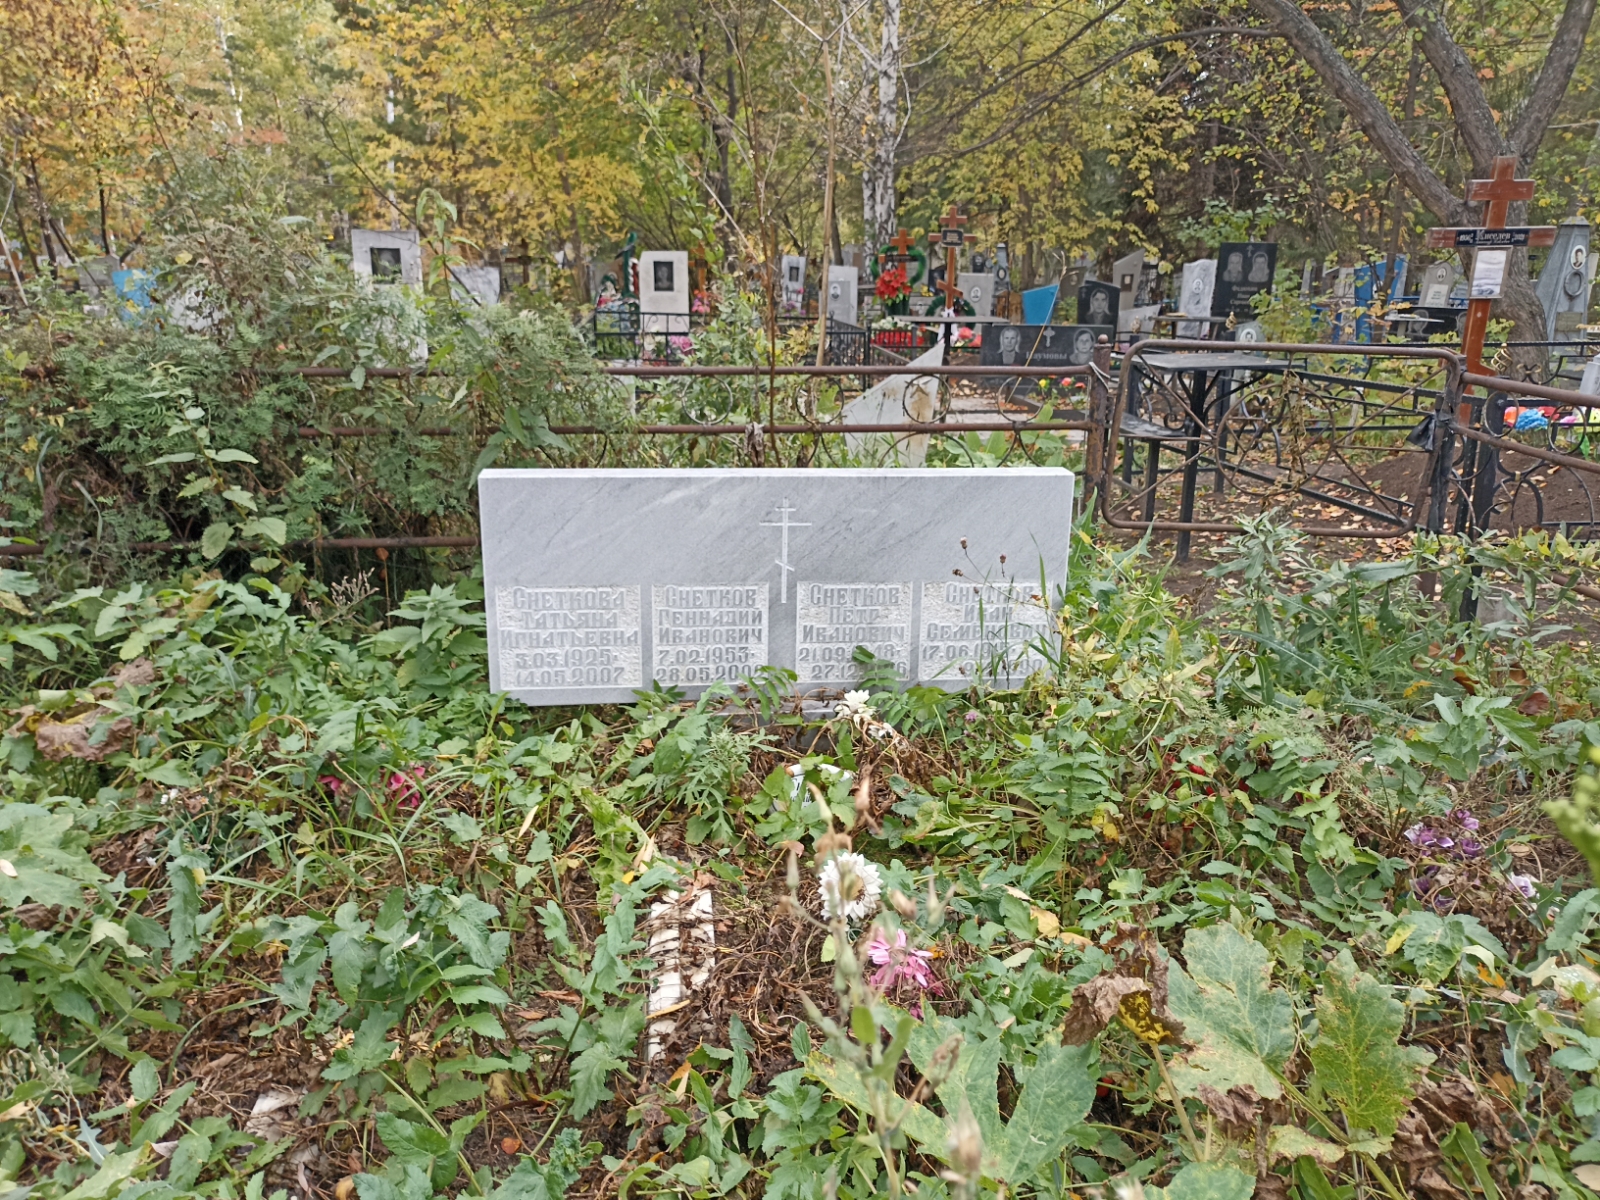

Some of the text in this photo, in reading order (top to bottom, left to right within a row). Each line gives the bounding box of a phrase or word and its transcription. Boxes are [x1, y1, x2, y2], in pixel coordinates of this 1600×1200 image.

[513, 586, 626, 609] СНЕТКОВА
[665, 585, 758, 607] СНЕТКОВ
[810, 583, 901, 606] СНЕТКОВ
[521, 610, 619, 629] ТАТЬЯНА
[658, 606, 763, 626] ГЕННАДИЙ
[500, 629, 639, 647] ИГНАТЬЕВНА
[658, 626, 763, 644] ИВАНОВИЧ
[802, 624, 906, 642] ИВАНОВИЧ
[516, 667, 625, 687] 14.05.2007
